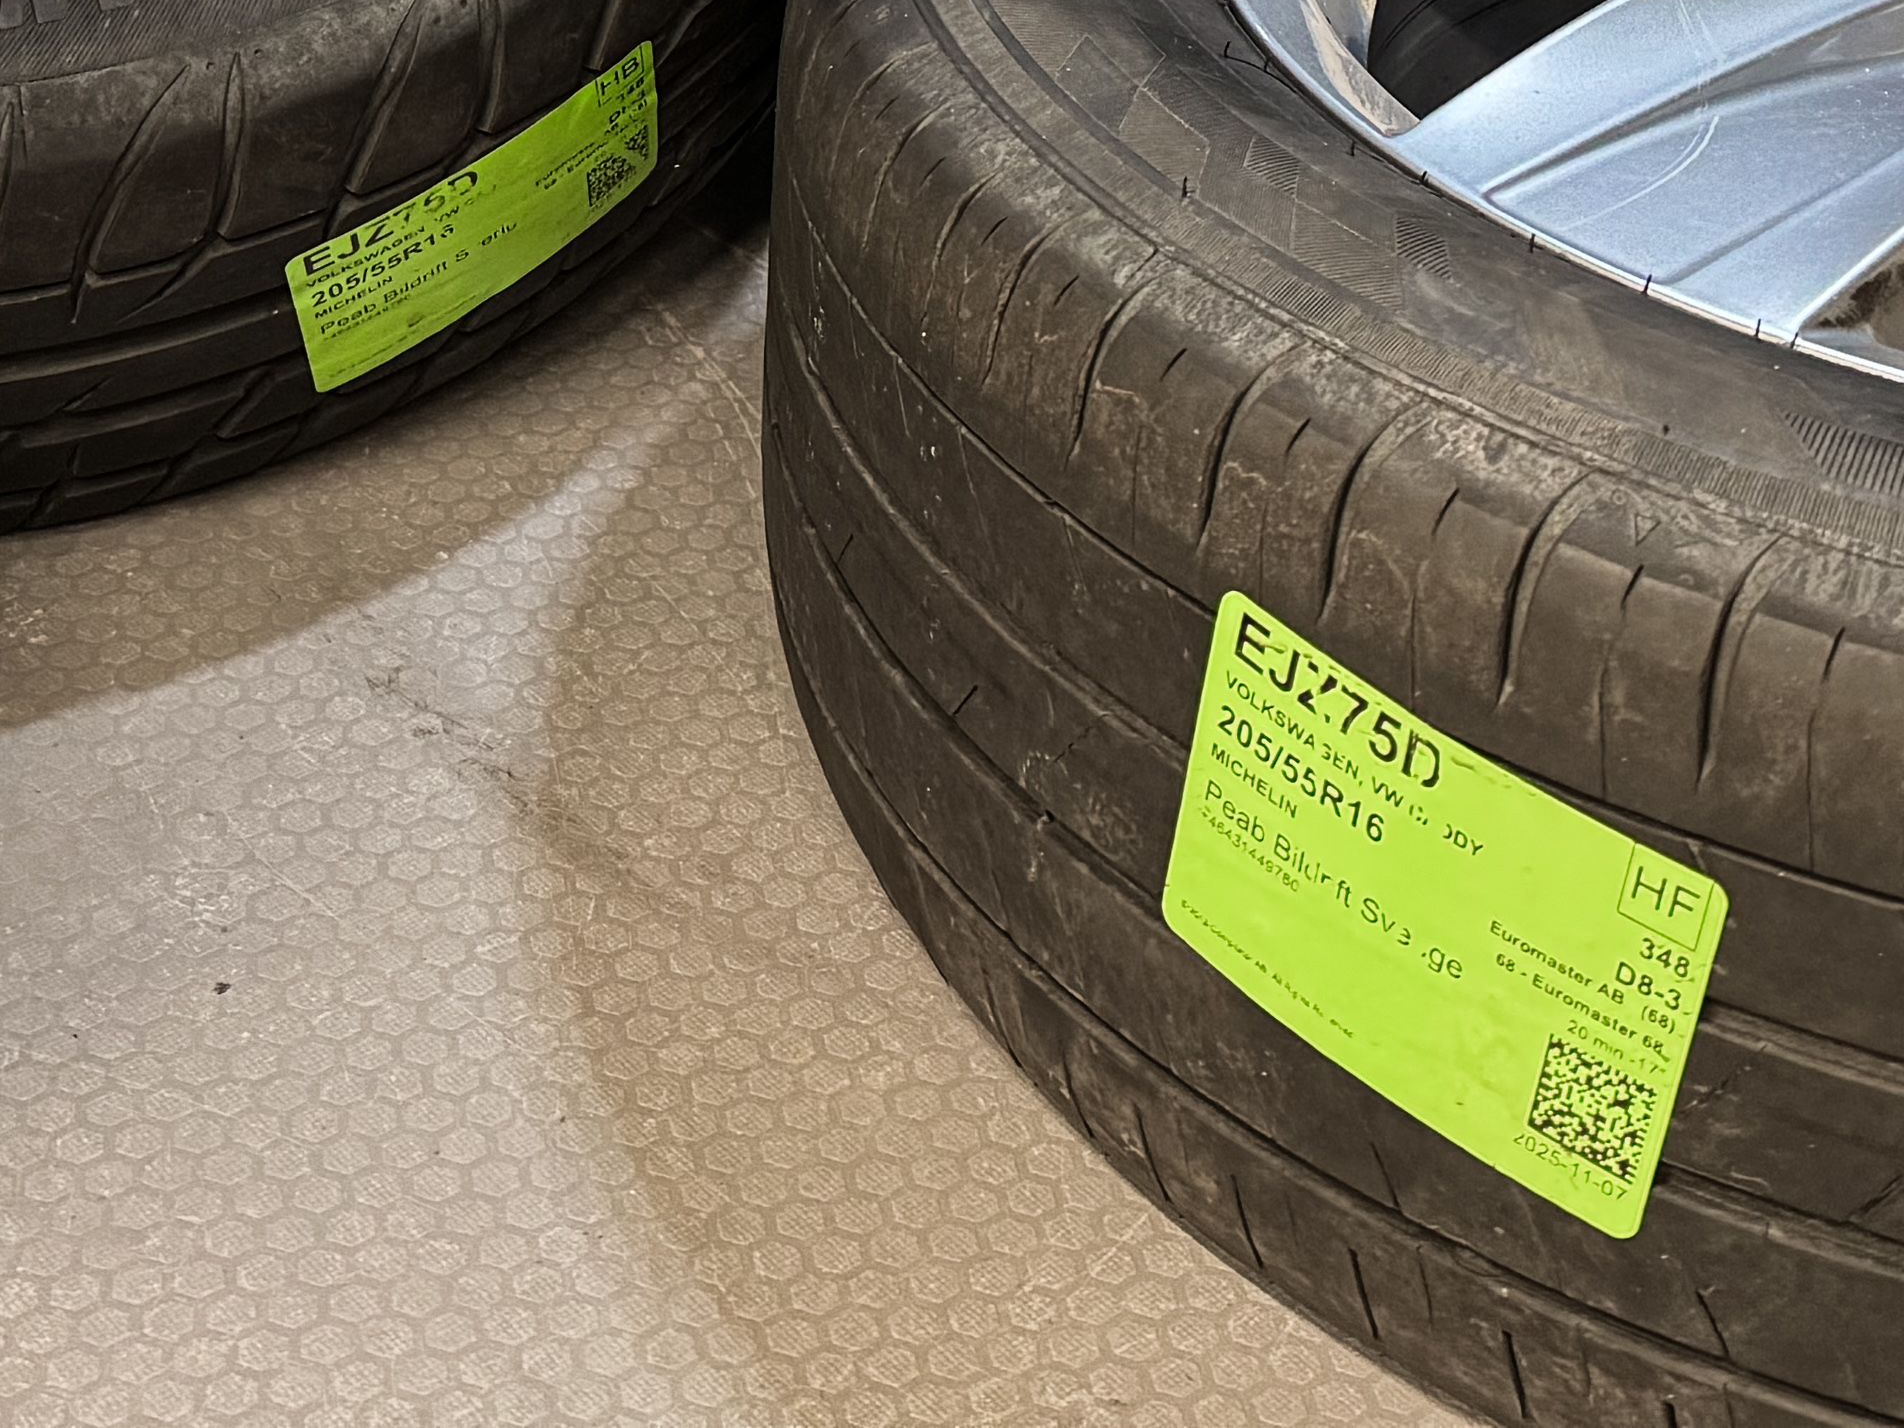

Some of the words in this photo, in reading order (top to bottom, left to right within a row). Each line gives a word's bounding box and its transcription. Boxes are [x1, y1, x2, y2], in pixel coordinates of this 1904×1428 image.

[314, 275, 394, 320] MICHELIN
[1210, 742, 1298, 820] MICHELIN
[1216, 704, 1385, 843] 205/55R16
[1370, 774, 1405, 809] VW
[1204, 779, 1266, 843] Peab
[1273, 833, 1354, 908] Bildrft
[1631, 865, 1701, 918] HF
[1490, 920, 1594, 987] Euromaster
[1597, 981, 1625, 1006] AB
[1640, 1005, 1676, 1035] (68)
[1615, 961, 1683, 1012] D8-3
[1639, 937, 1691, 979] 348
[1495, 953, 1516, 973] 68
[1532, 972, 1637, 1041] Euromaster
[1566, 1019, 1588, 1041] 20
[1512, 1132, 1629, 1201] 2025-11-07
